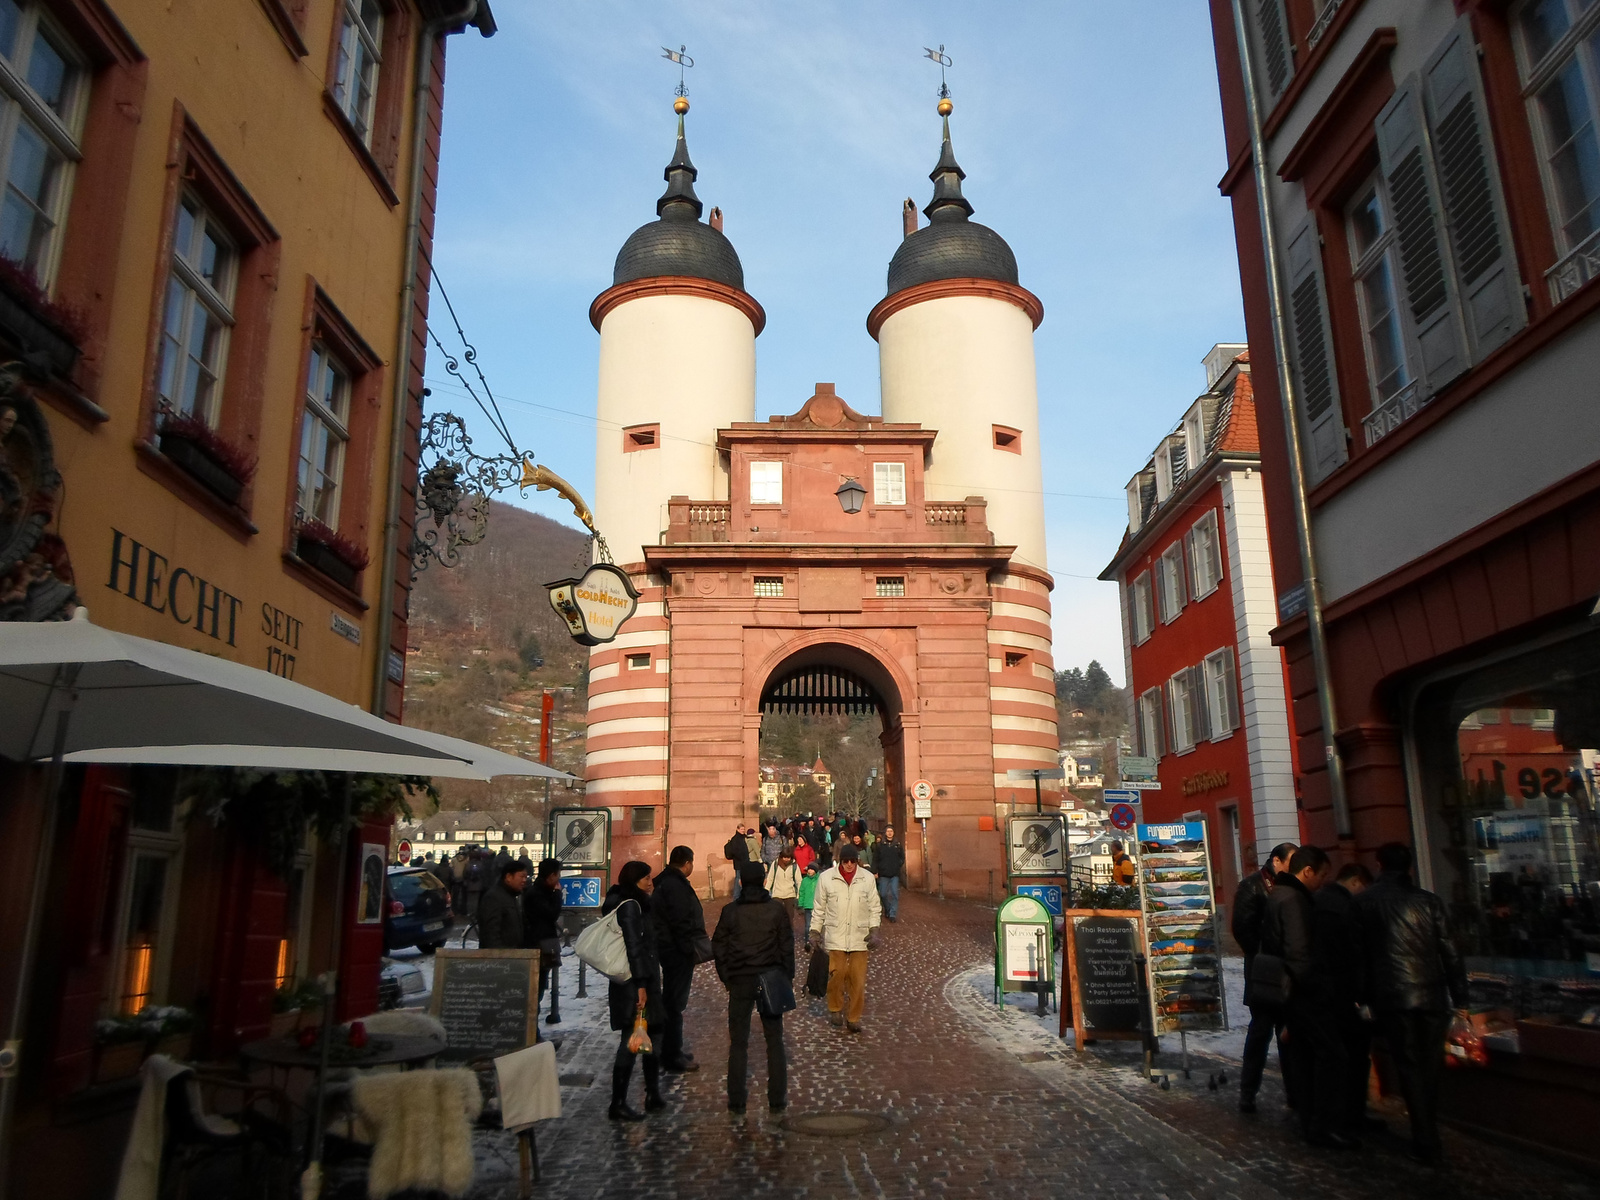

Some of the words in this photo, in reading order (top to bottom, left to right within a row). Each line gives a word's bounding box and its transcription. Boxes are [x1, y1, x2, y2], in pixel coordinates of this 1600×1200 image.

[105, 526, 243, 648] HECHT
[262, 602, 304, 650] SEIT
[589, 611, 614, 628] Hotel
[267, 645, 296, 681] 1717
[567, 851, 592, 861] ZONE
[1025, 858, 1051, 868] ZONE
[1093, 989, 1109, 997] Party
